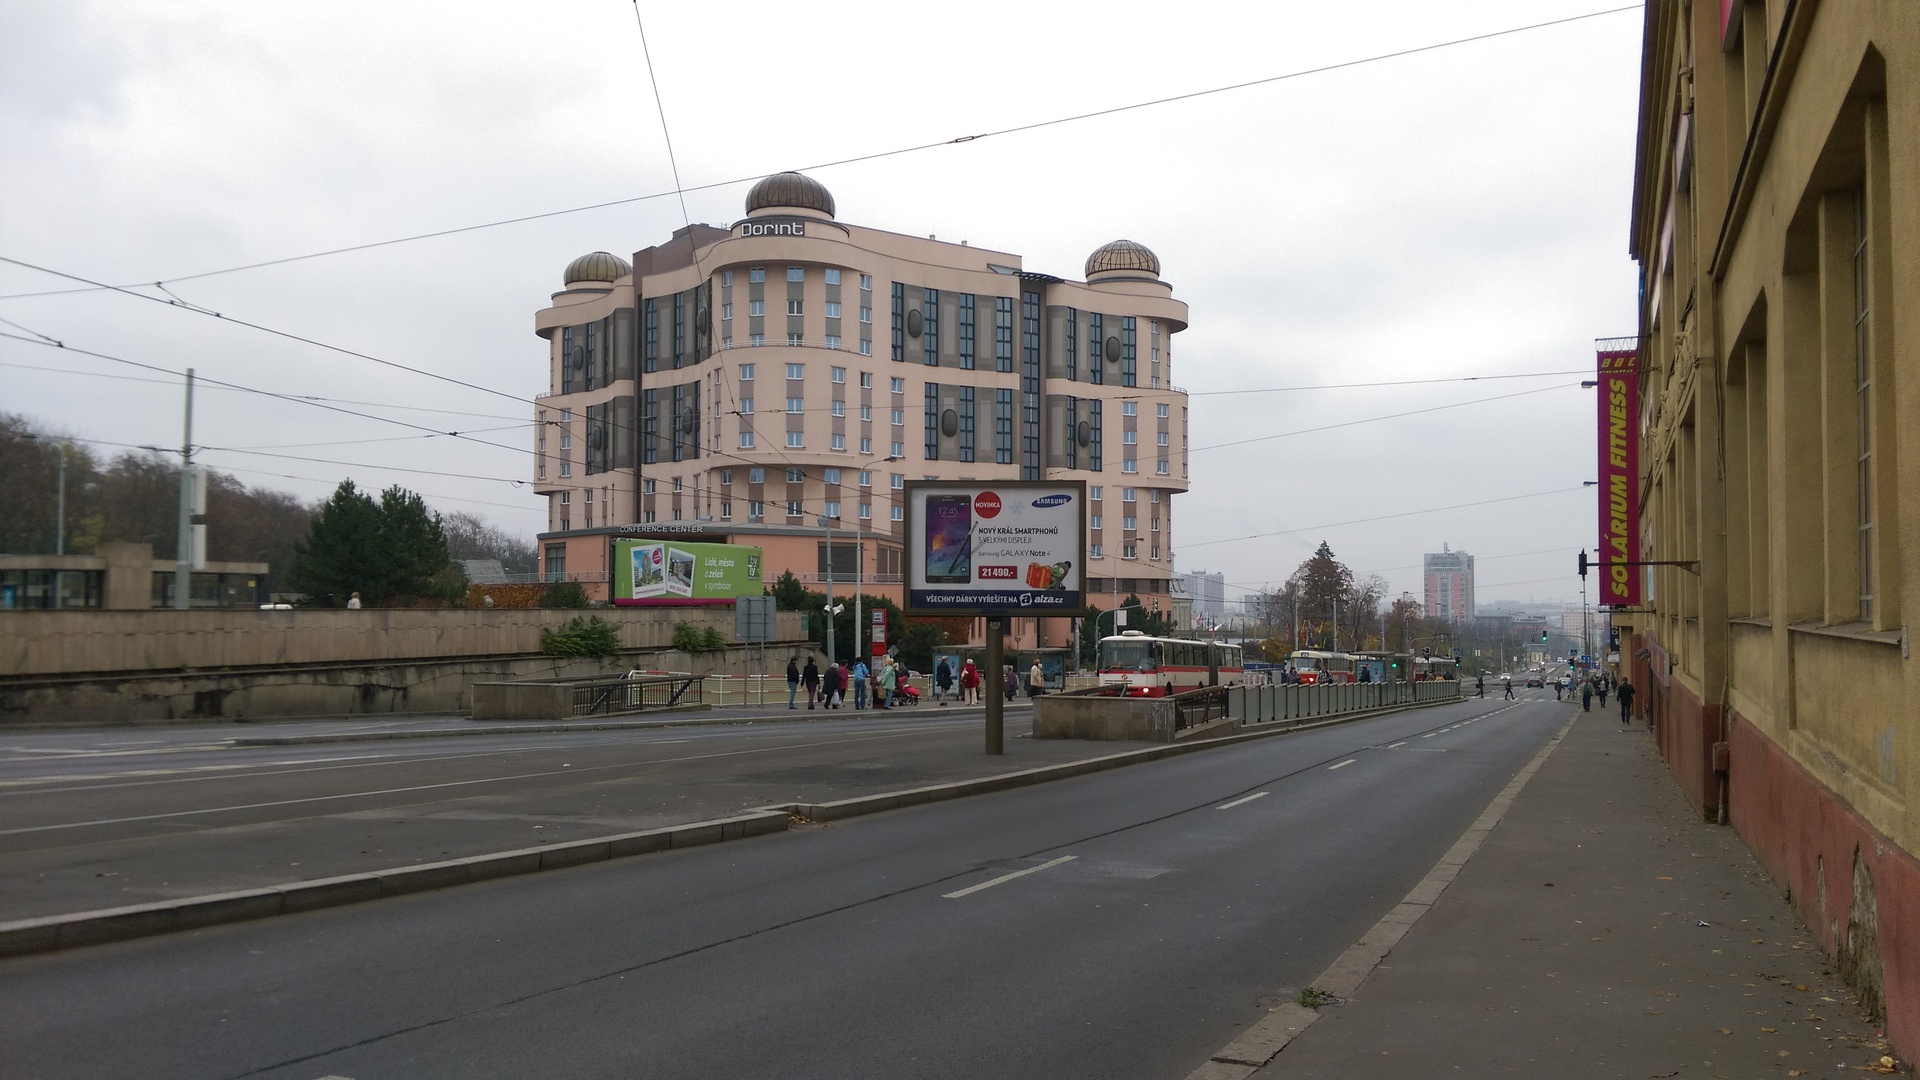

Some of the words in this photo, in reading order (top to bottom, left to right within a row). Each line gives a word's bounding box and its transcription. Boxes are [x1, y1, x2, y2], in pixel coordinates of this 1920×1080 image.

[742, 222, 803, 236] Dorint
[1610, 378, 1627, 469] FITNESS
[978, 526, 996, 535] NOVÝ
[997, 526, 1014, 535] KRÁL
[1014, 526, 1058, 535] SMARTPHONŮ
[1604, 474, 1628, 598] SOLÁRIUM
[983, 536, 1007, 544] VELKÝMI
[926, 594, 955, 603] VŠECHNY
[956, 594, 978, 603] DÁRKY
[978, 593, 1008, 604] VYŘEŠÍTE
[1034, 595, 1064, 604] alza.cz
